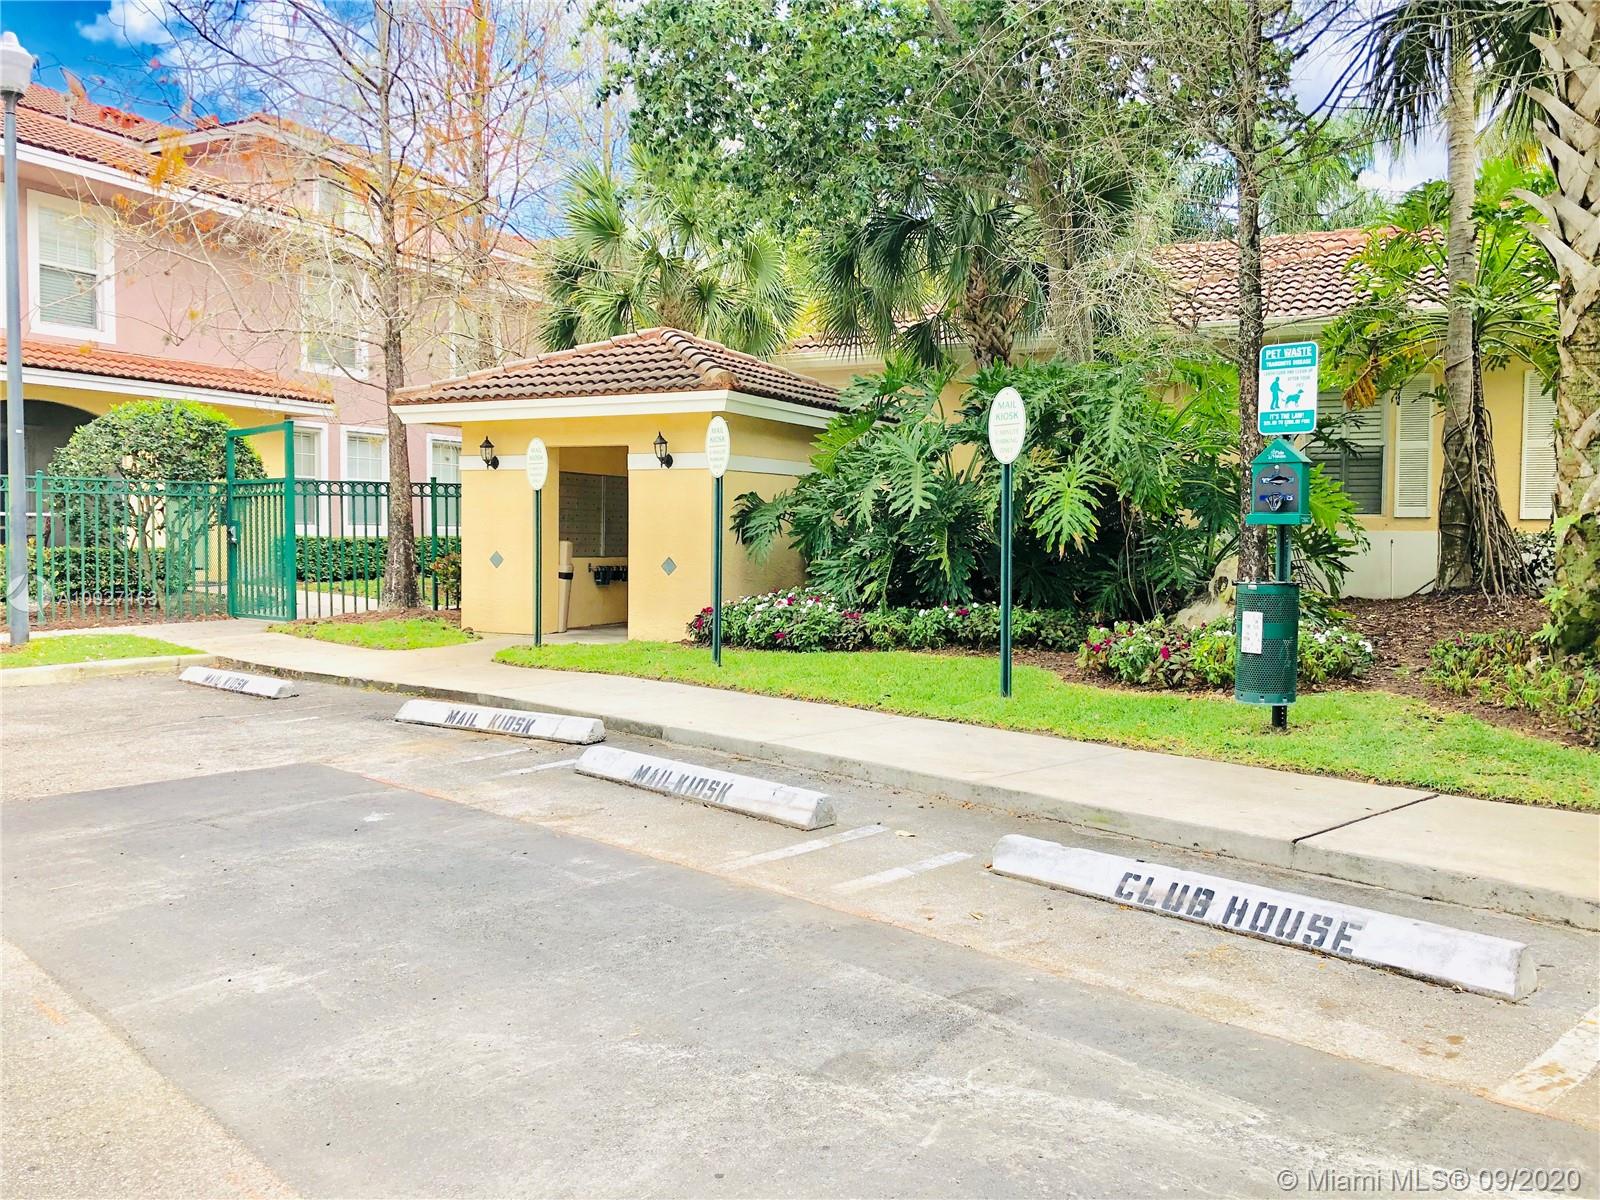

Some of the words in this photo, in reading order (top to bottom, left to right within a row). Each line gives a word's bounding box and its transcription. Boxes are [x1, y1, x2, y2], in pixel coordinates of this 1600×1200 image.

[1266, 349, 1281, 359] PET
[1283, 346, 1312, 358] WASTE
[997, 400, 1017, 410] MAIL
[995, 412, 1019, 421] KIOSK
[445, 709, 479, 727] MAIL
[488, 713, 536, 734] KIOSK
[632, 764, 673, 788] MAIL
[673, 774, 734, 803] KIOSK
[1114, 871, 1216, 918] CLUB
[1221, 895, 1364, 955] HOUSE
